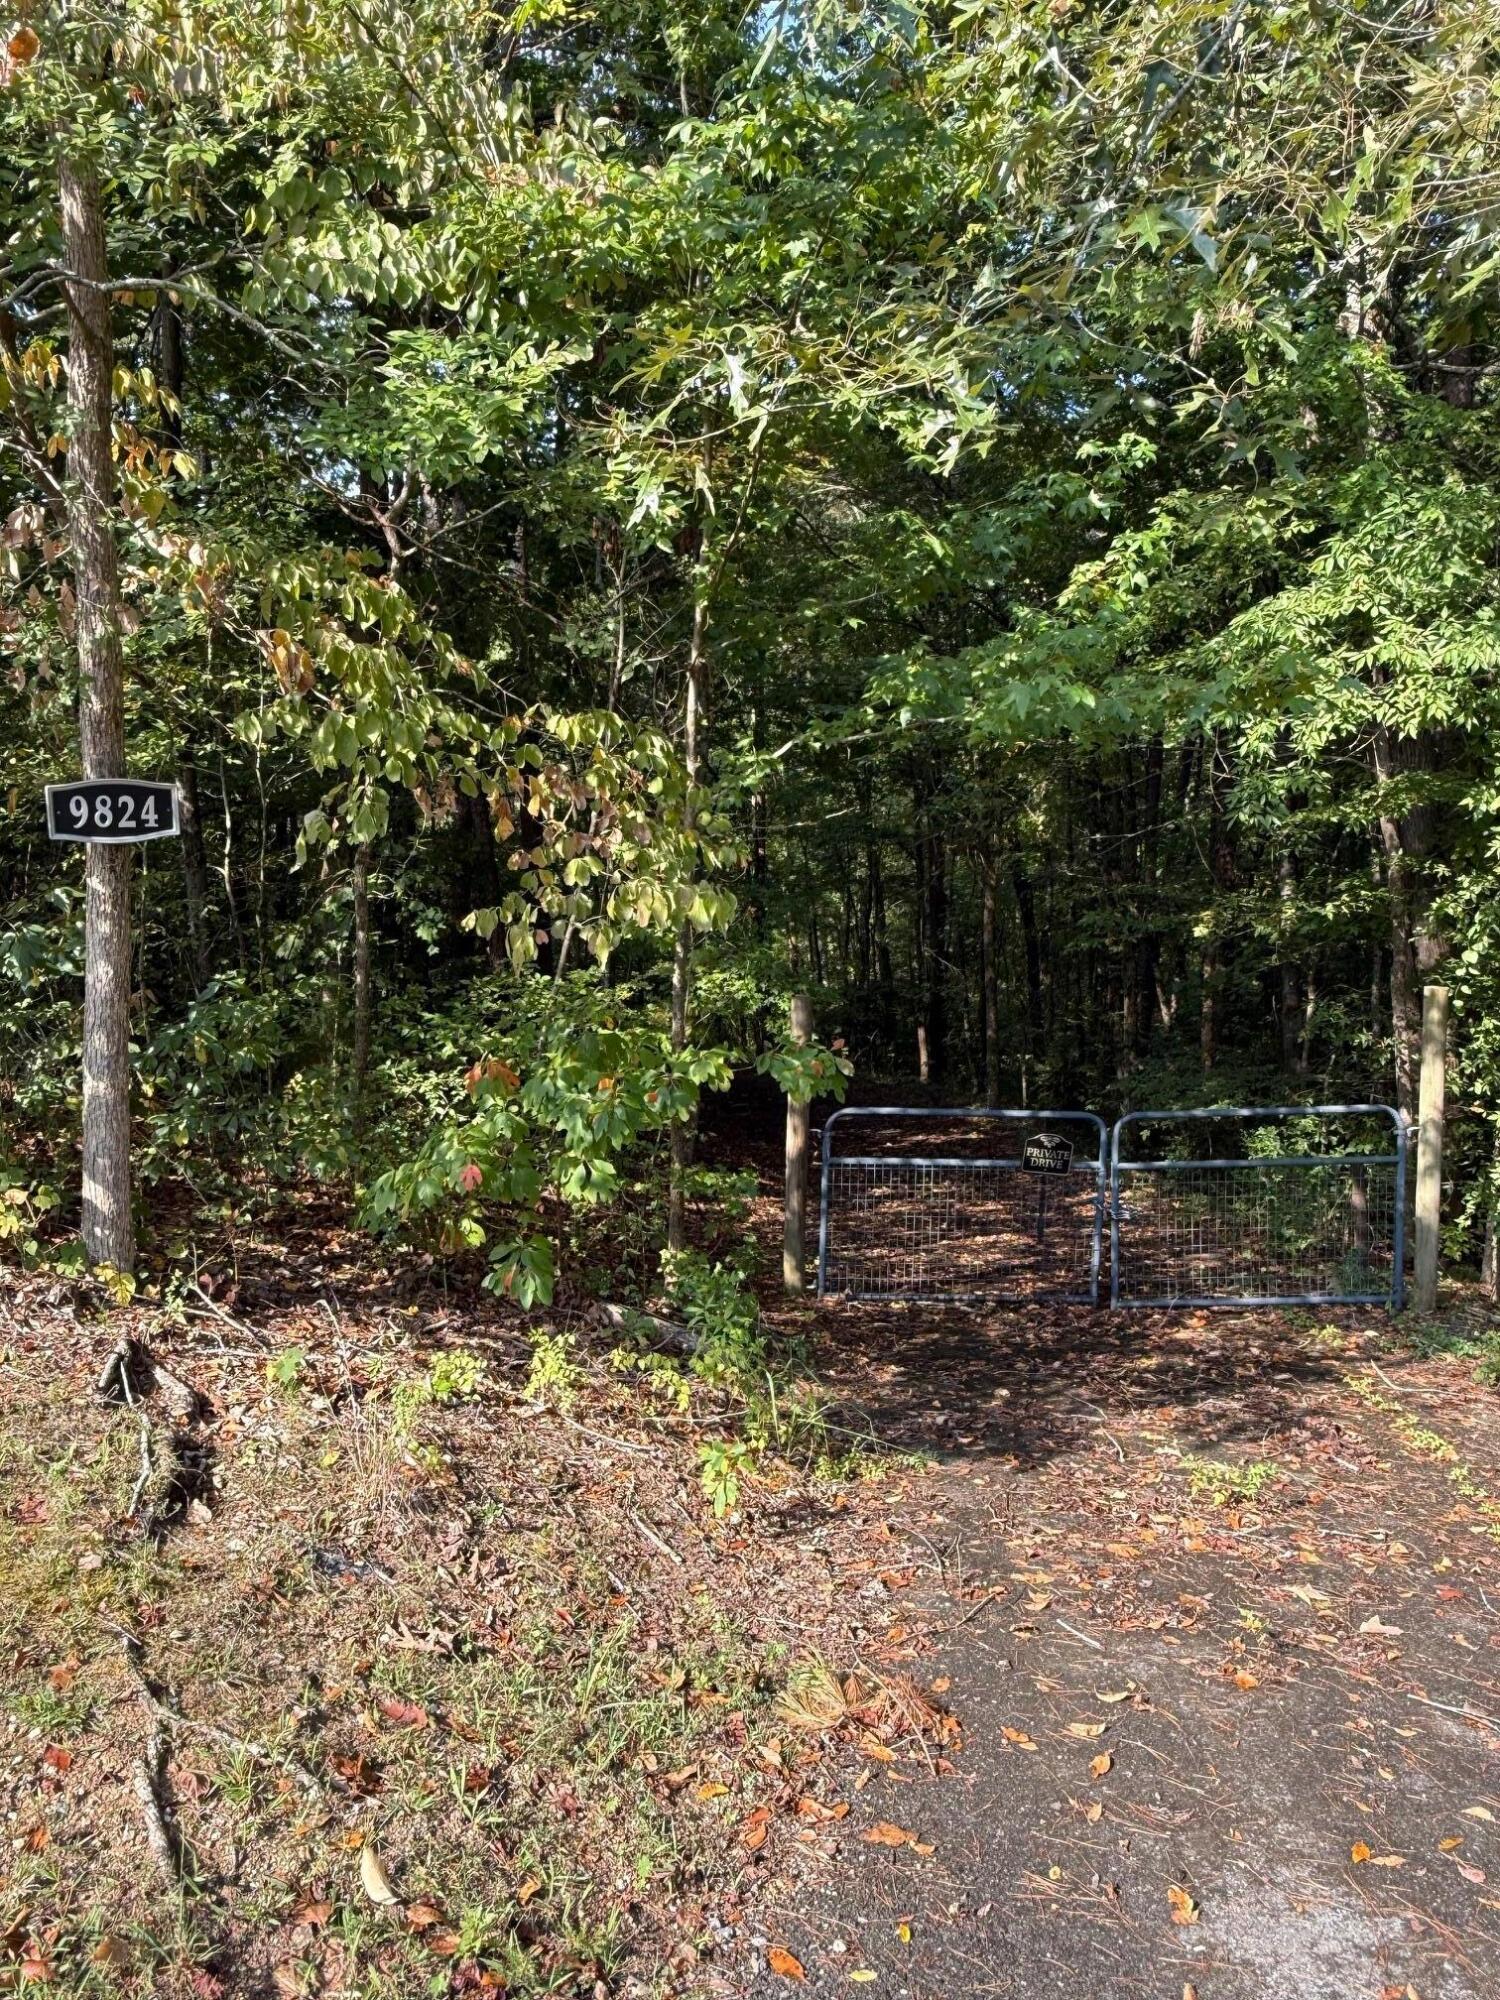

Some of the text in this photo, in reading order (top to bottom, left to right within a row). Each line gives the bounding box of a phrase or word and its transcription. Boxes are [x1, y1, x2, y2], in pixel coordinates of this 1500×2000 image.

[69, 795, 159, 829] 9824
[1026, 1147, 1070, 1160] PRIVATE
[1030, 1157, 1064, 1169] DRIVE
